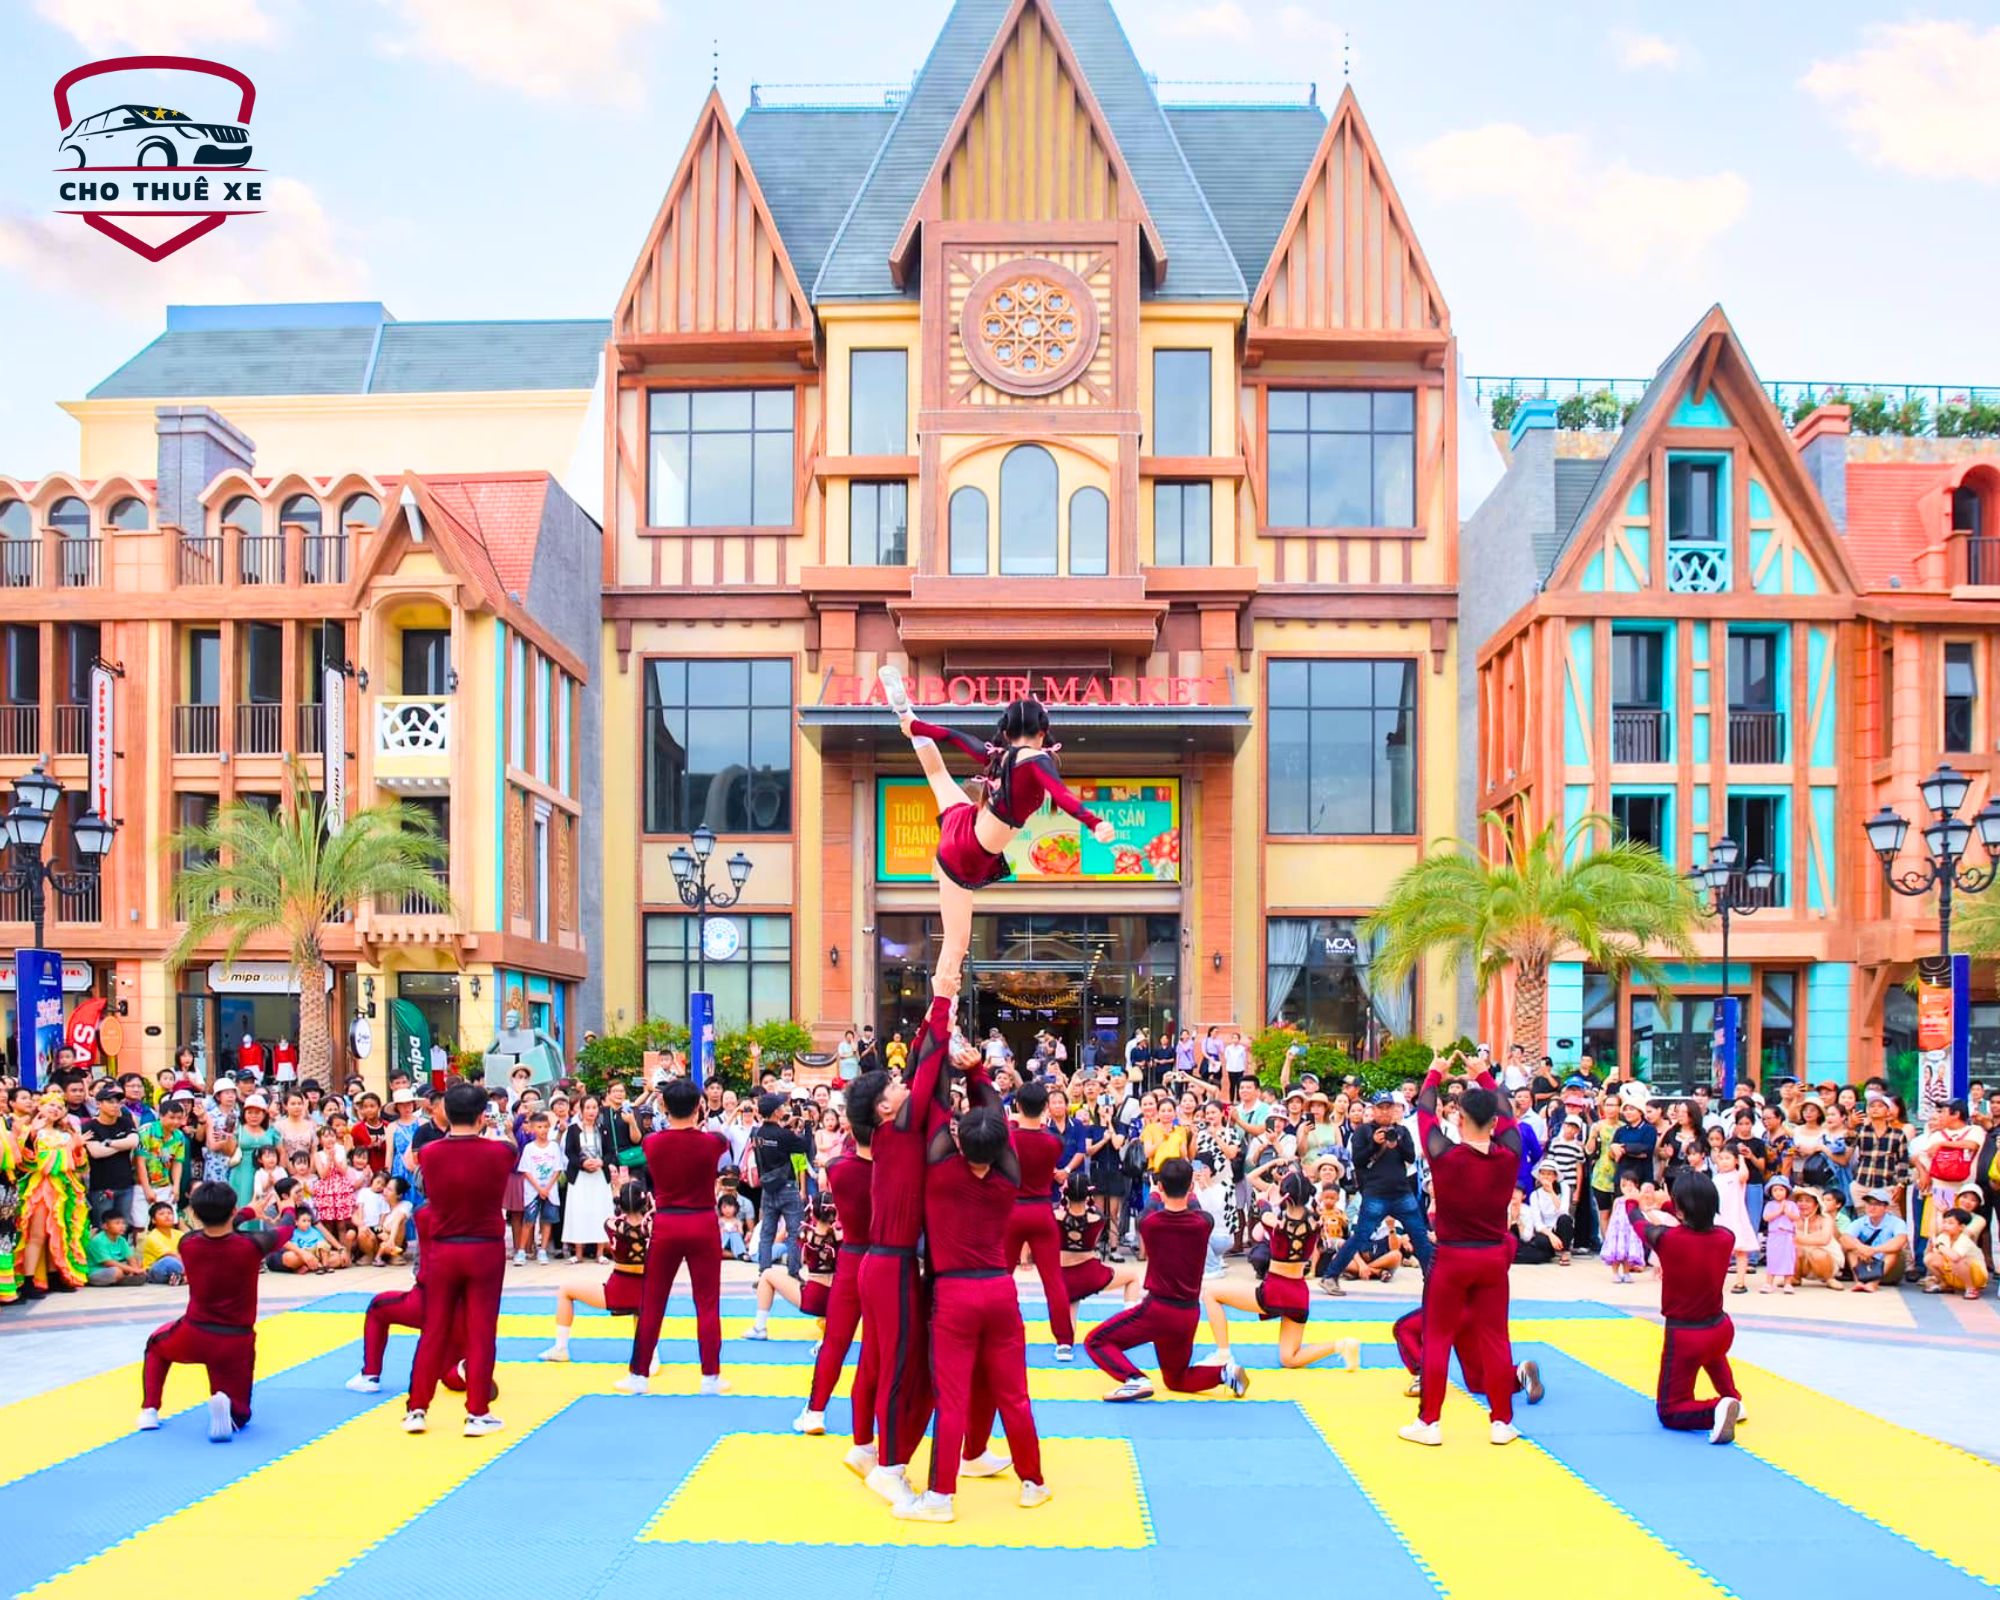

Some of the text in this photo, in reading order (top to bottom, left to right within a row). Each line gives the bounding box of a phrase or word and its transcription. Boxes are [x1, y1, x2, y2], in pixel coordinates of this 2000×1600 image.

[834, 676, 1216, 706] HARBOUR MARKET
[893, 825, 940, 846] TRANG
[230, 973, 261, 984] mipa
[407, 1035, 425, 1081] mipa
